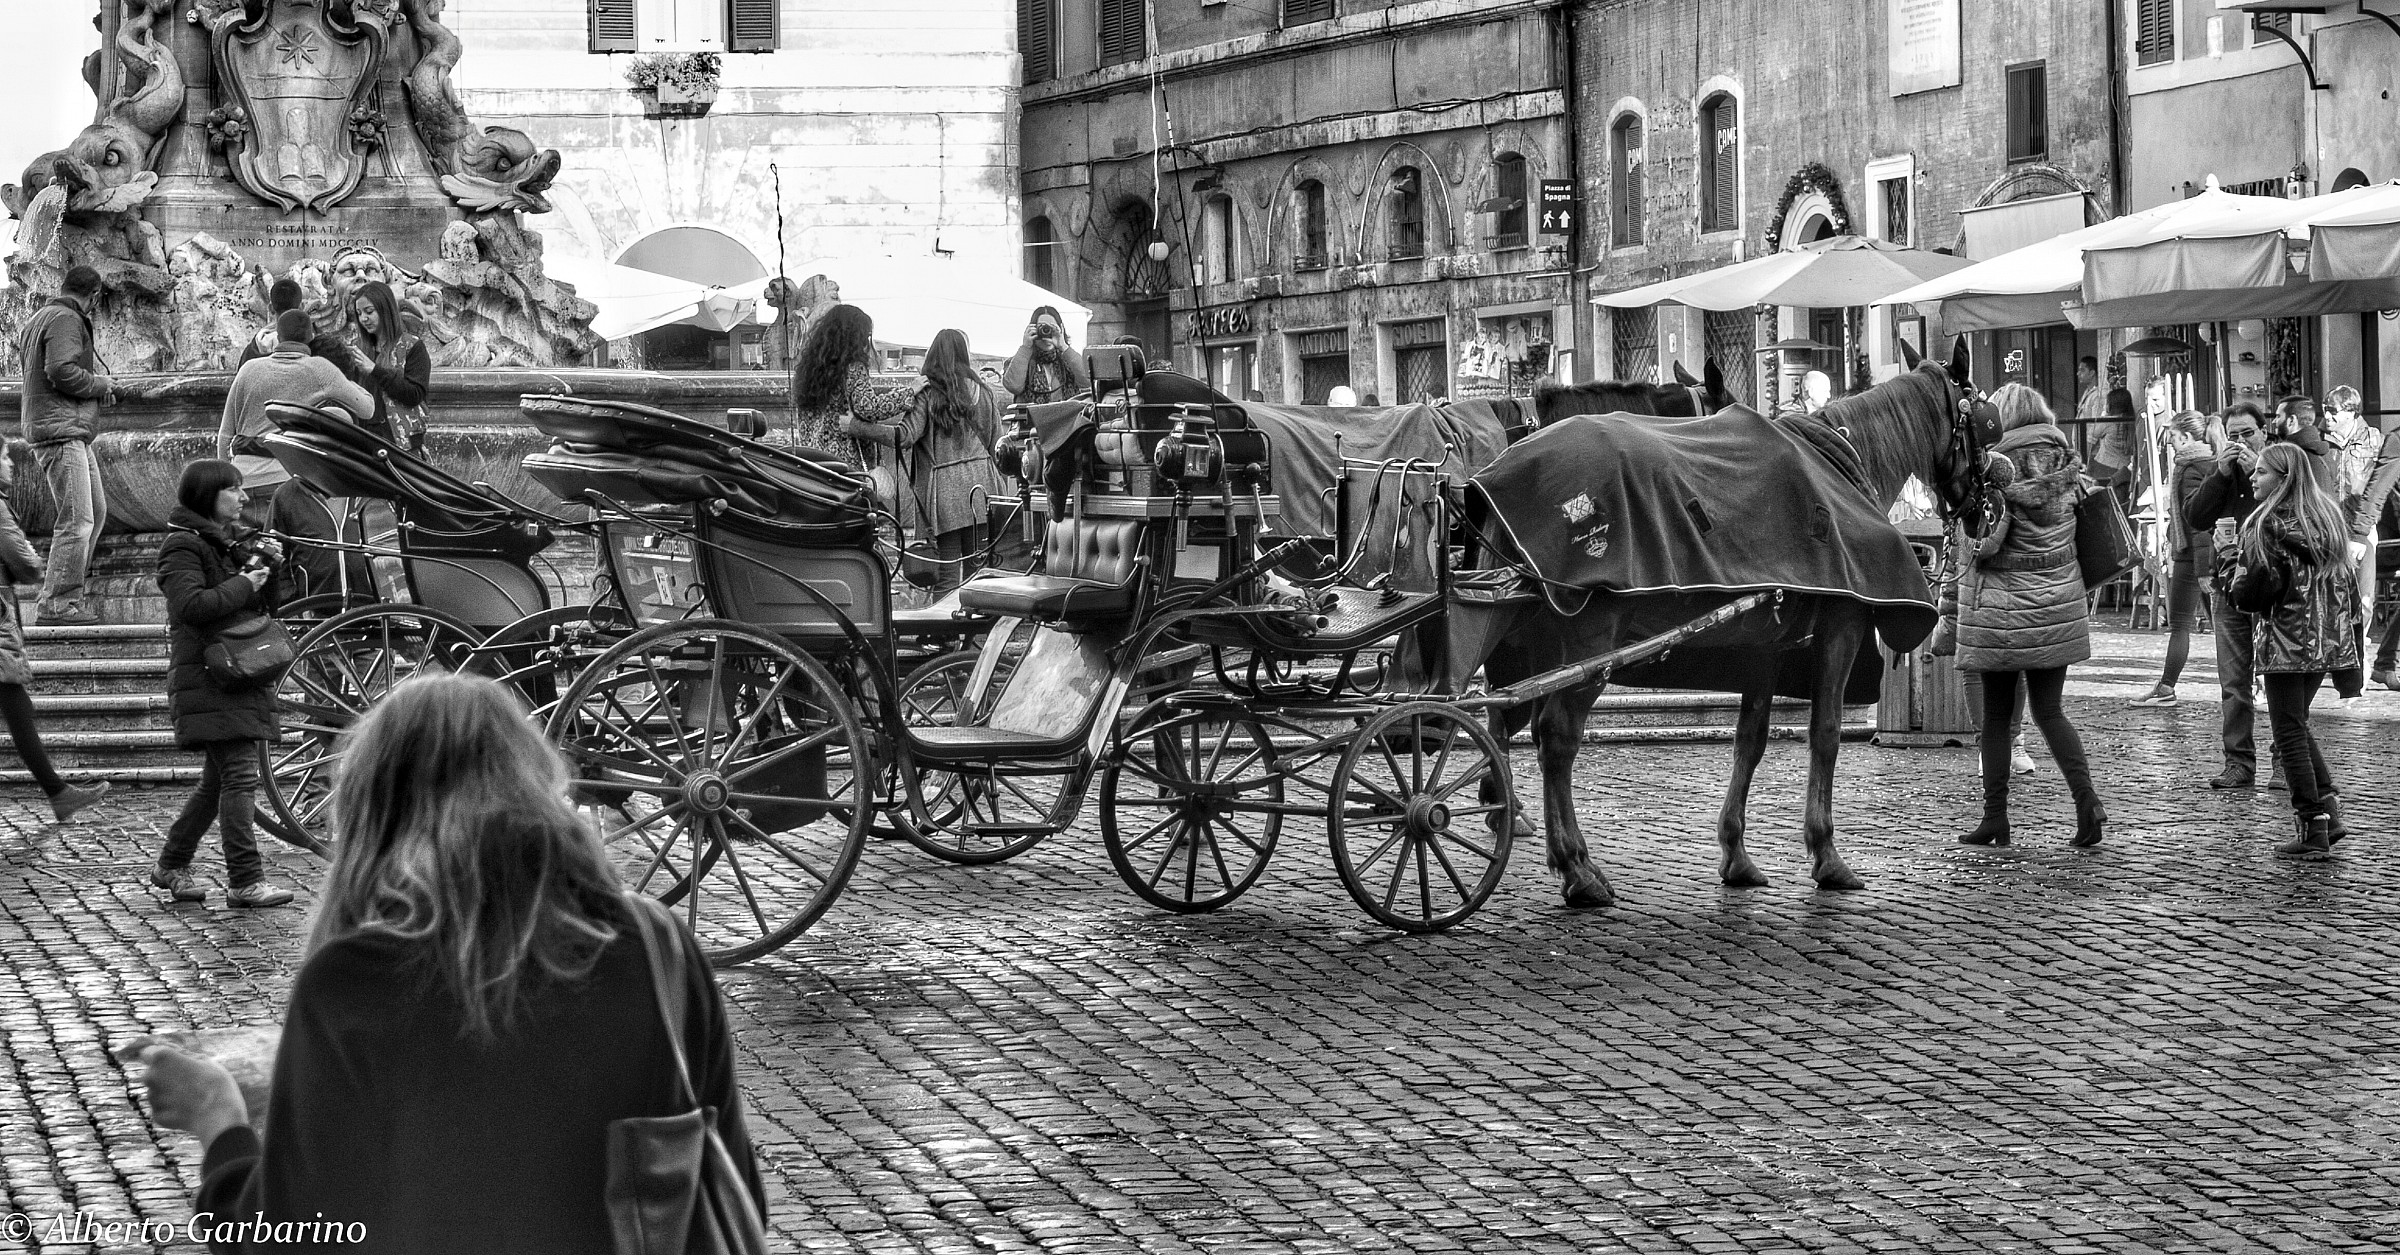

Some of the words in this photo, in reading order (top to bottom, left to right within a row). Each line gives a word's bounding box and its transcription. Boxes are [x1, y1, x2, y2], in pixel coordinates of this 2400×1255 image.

[1544, 193, 1571, 202] Spagna
[230, 238, 264, 248] ANNO
[268, 238, 315, 248] DOMINI
[1300, 330, 1348, 355] ANTICOLI
